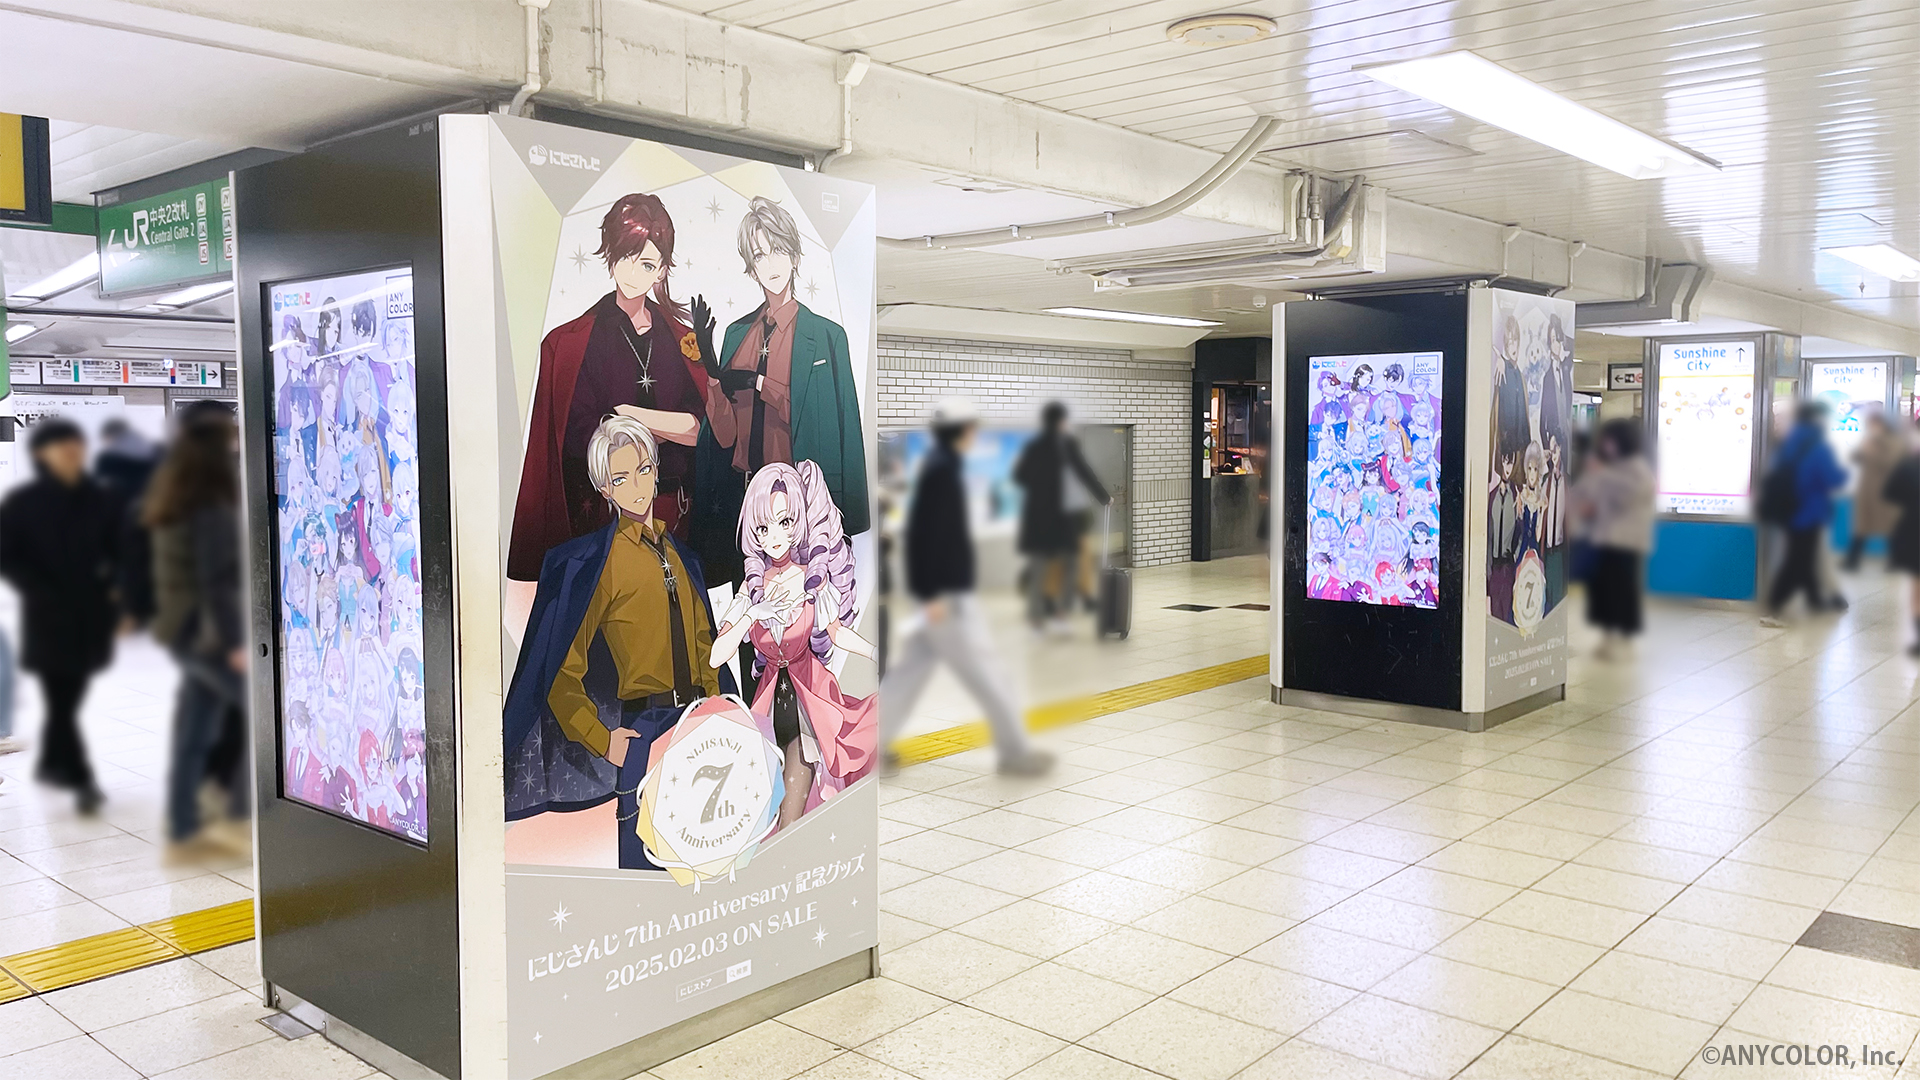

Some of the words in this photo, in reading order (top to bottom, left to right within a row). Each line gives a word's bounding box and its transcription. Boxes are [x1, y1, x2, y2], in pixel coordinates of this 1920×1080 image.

[548, 149, 601, 172] にじさんじ
[150, 200, 190, 228] 中央2改札
[124, 210, 151, 249] JR
[150, 226, 173, 245] Central
[174, 221, 189, 240] Gate
[190, 222, 195, 237] 2
[389, 292, 404, 303] ANY
[389, 304, 414, 314] COLOR
[1674, 346, 1727, 359] Sunshine
[1687, 360, 1712, 372] City
[1823, 366, 1865, 376] Sunshine
[1833, 376, 1853, 385] City
[686, 737, 743, 764] NIJISANJI
[390, 817, 421, 834] ANYCOLOR,
[676, 808, 752, 849] Anniversary
[528, 934, 621, 982] にじさんじ
[624, 920, 662, 948] 7th
[666, 881, 792, 936] Anniversary
[794, 853, 866, 894] 記念グッズ
[605, 932, 728, 992] 2025.02.03
[732, 919, 764, 947] ON
[767, 901, 818, 935] SALE
[680, 978, 713, 997] にじストア
